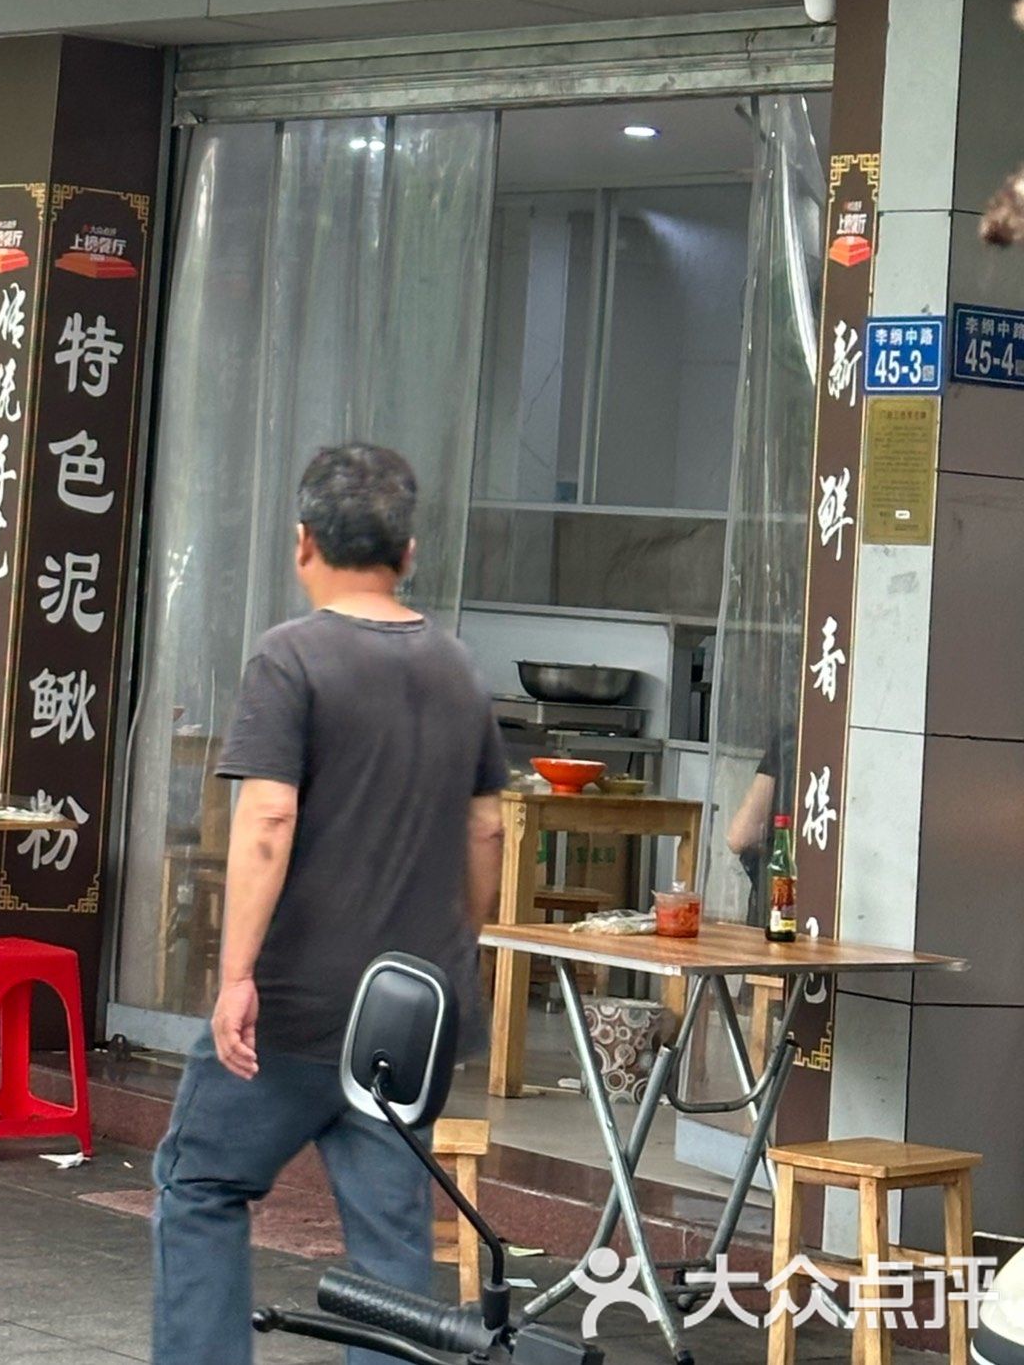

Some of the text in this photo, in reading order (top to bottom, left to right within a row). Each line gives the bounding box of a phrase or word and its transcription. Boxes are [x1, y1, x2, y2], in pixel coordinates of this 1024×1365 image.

[69, 233, 127, 256] 上榜餐厅
[874, 349, 922, 385] 45-3
[964, 338, 1014, 377] 45-4
[16, 312, 126, 873] 特色泥鳅粉
